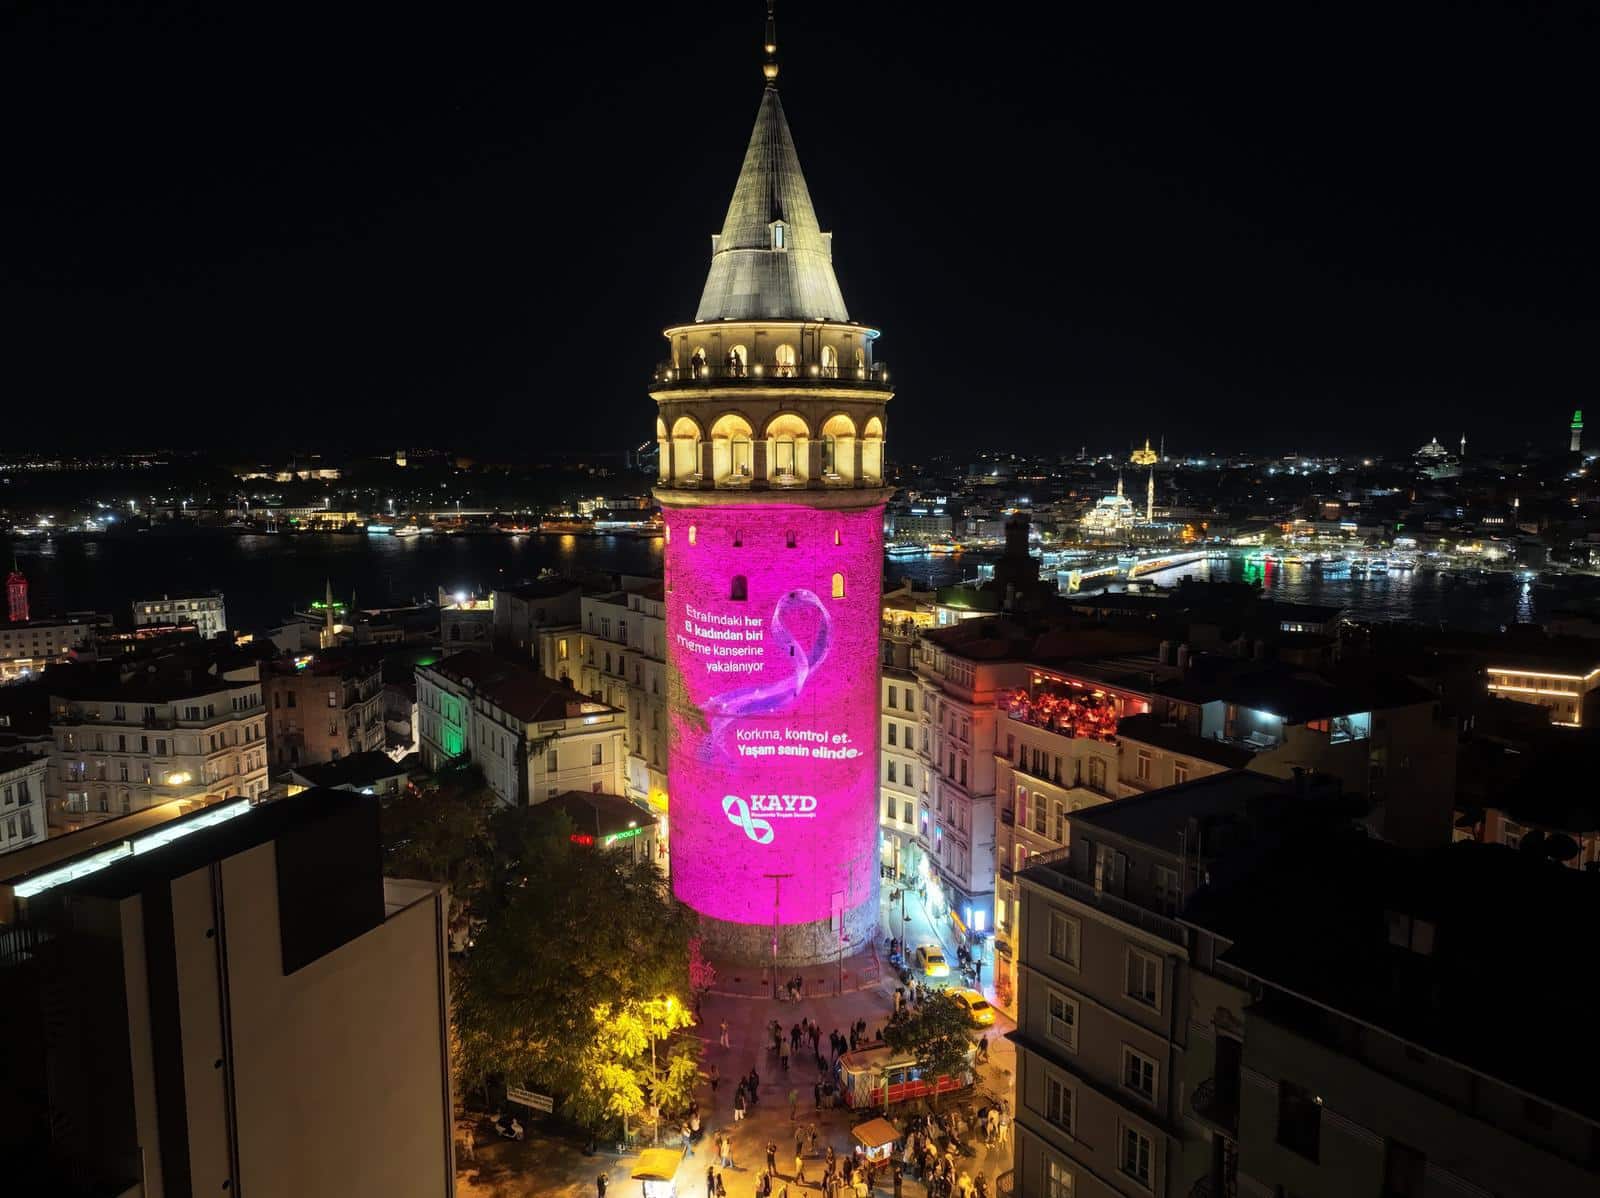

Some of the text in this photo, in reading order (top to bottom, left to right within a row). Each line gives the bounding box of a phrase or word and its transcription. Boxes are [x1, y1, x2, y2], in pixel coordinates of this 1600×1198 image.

[745, 616, 763, 627] her
[695, 623, 743, 641] kadından
[746, 629, 763, 641] biri
[677, 634, 764, 656] meme kanserine
[706, 661, 764, 674] yakalanıyor
[736, 729, 783, 741] Korkma,
[785, 728, 828, 743] kontrol
[738, 744, 775, 758] Yaşam
[778, 744, 809, 757] senin
[750, 795, 817, 811] KAYD
